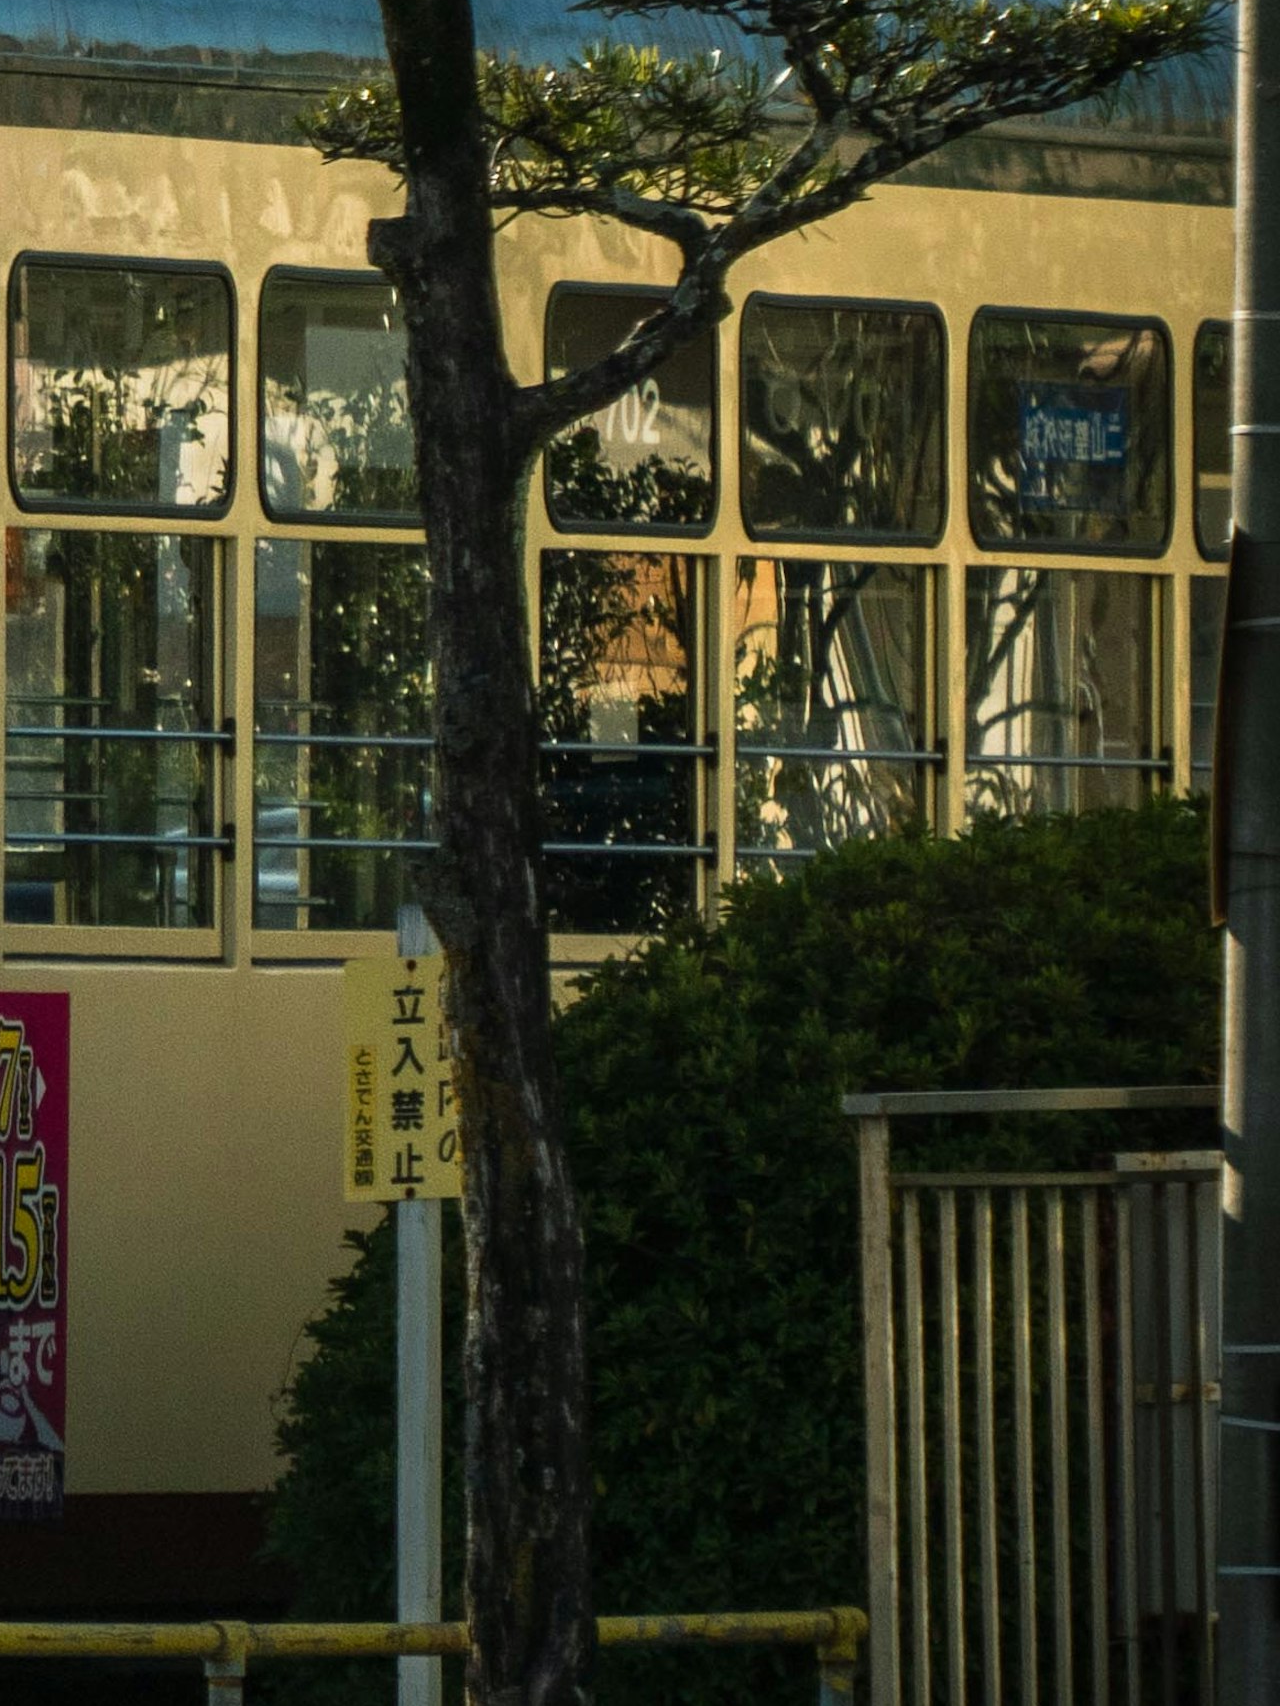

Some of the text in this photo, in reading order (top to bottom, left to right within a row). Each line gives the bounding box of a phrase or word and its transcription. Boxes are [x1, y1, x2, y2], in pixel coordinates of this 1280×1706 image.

[391, 985, 426, 1186] 立入禁止
[8, 1317, 57, 1387] まで
